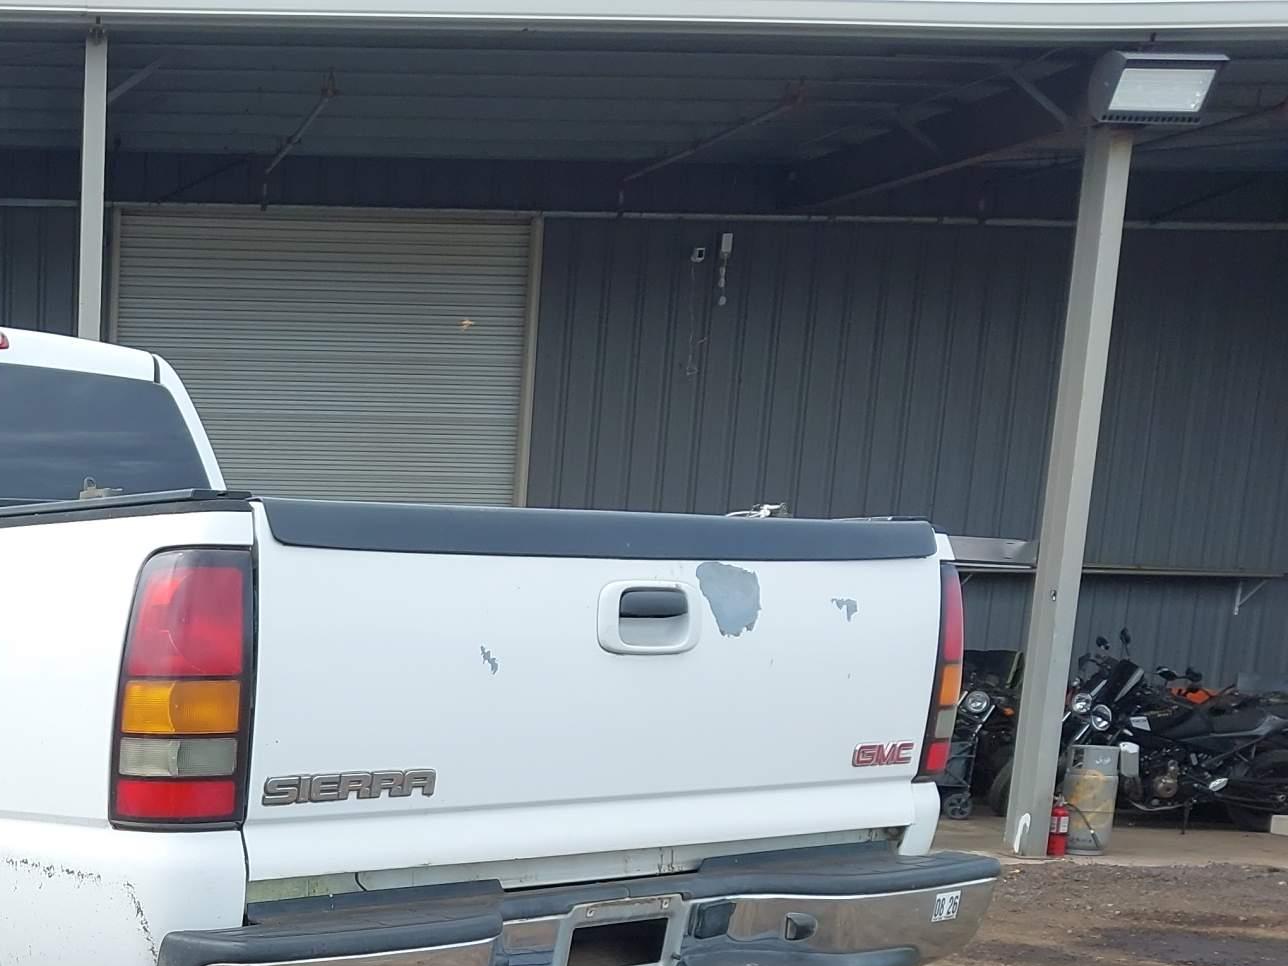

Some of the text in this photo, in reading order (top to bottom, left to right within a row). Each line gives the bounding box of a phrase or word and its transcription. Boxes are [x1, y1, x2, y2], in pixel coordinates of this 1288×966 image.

[852, 741, 914, 767] GMC
[262, 769, 436, 806] SIERRA
[947, 895, 959, 915] 26
